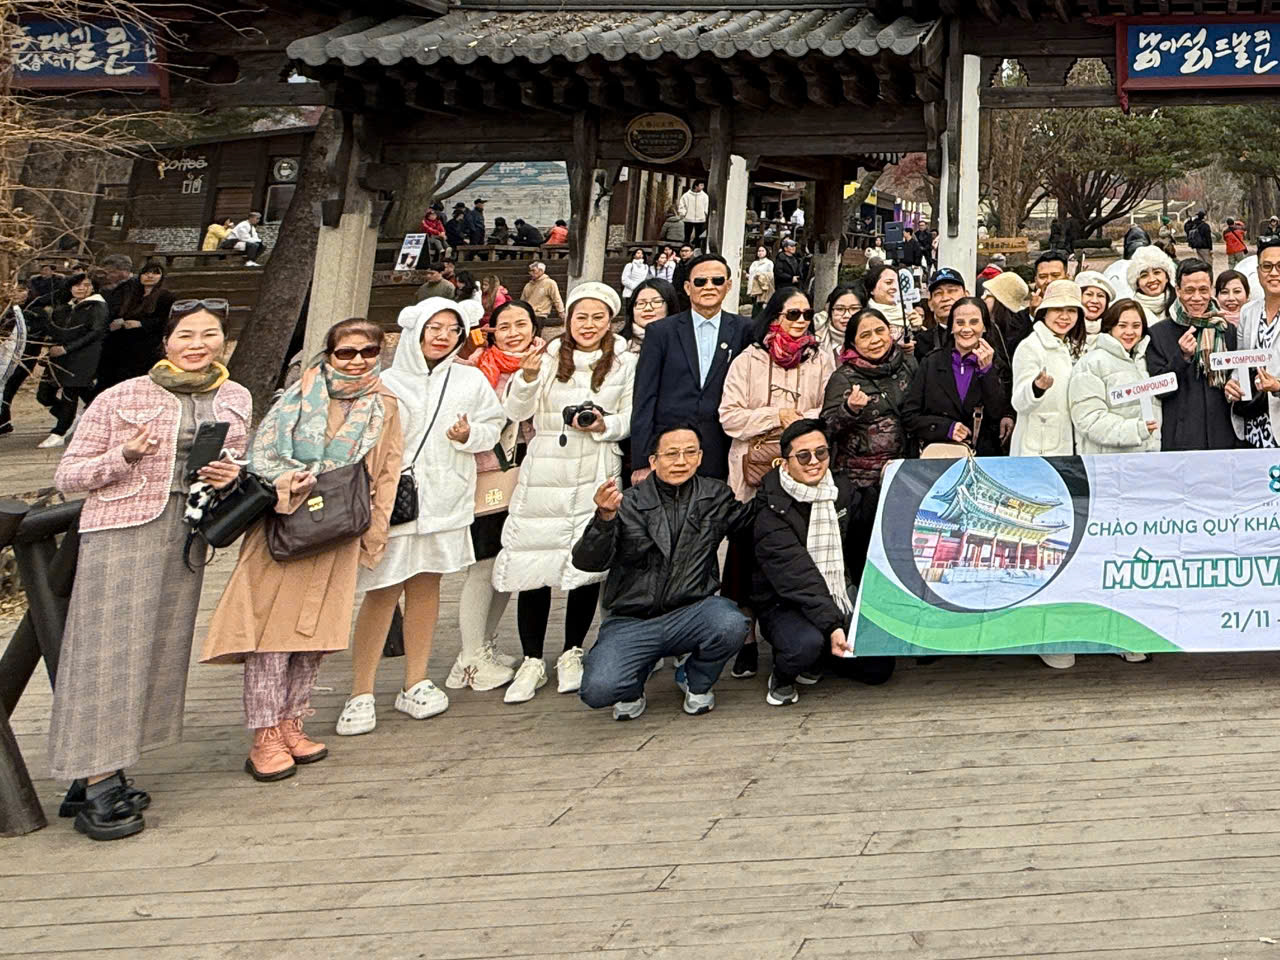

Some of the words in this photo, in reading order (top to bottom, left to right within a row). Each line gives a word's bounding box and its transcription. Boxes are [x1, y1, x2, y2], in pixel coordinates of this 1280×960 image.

[1087, 517, 1138, 537] CHÀO
[1143, 516, 1198, 535] MỪNG
[1203, 514, 1239, 536] QUÝ
[1103, 547, 1182, 590] MÙA
[1182, 557, 1253, 588] THU
[1220, 609, 1270, 632] 21/11
